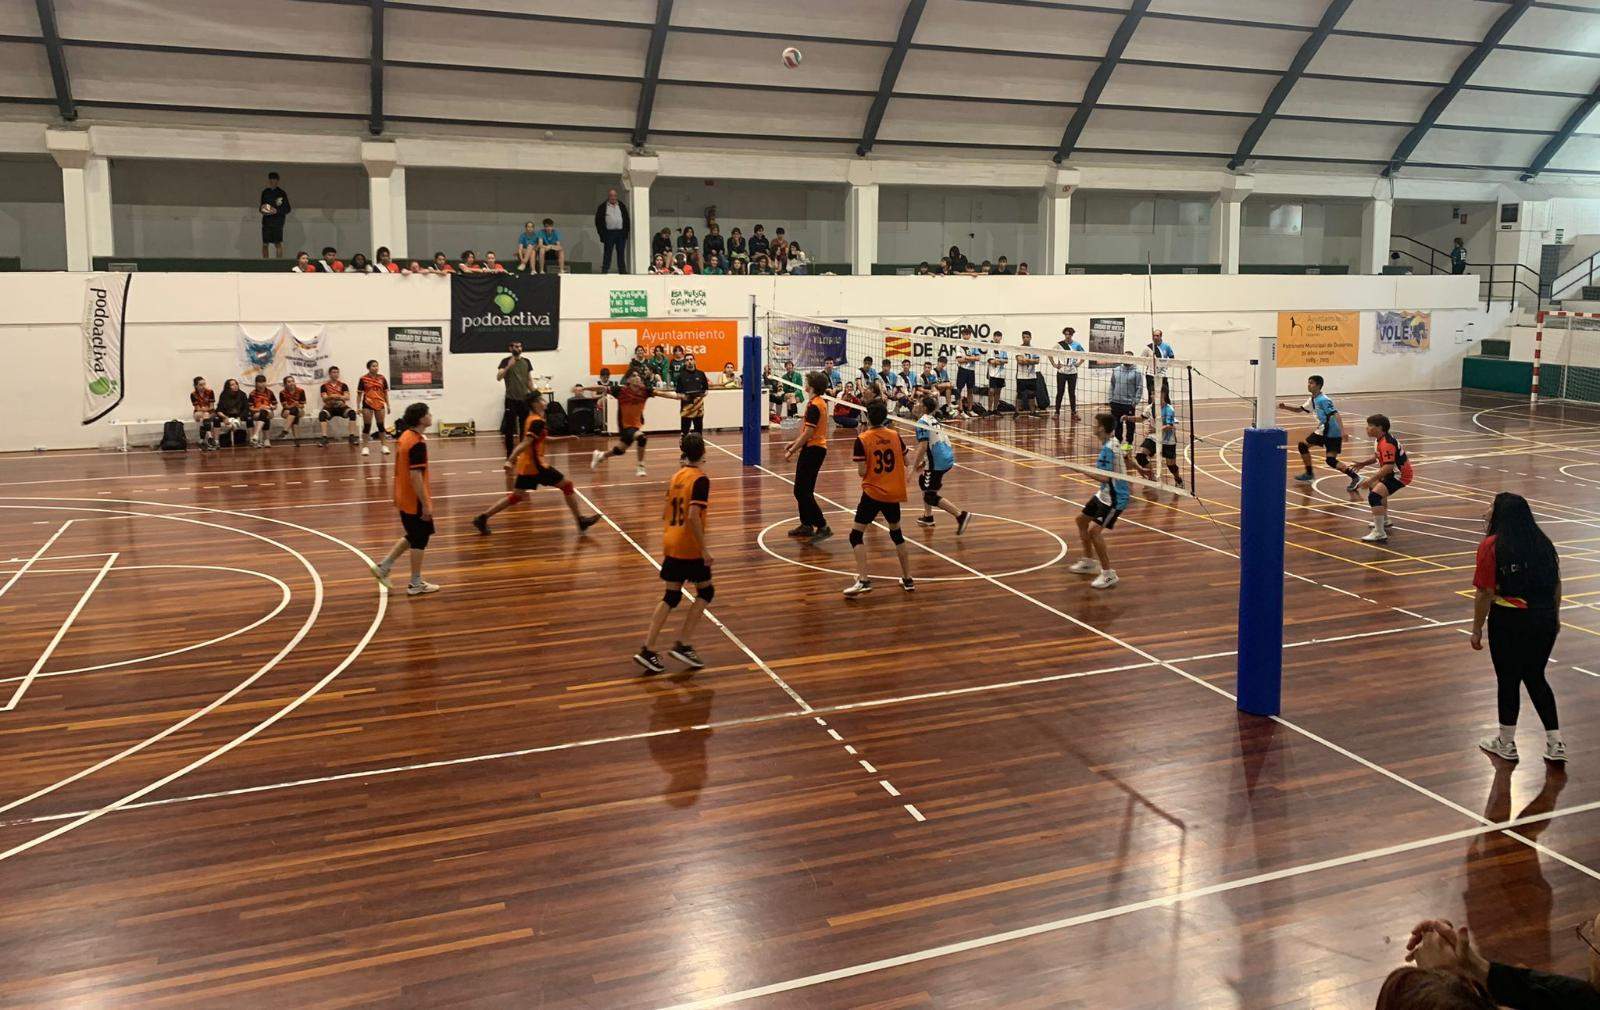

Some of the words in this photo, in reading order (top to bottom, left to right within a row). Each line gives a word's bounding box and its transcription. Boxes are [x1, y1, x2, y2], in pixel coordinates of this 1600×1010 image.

[684, 289, 706, 298] HUESCA
[90, 287, 109, 373] podoactiva
[462, 312, 551, 333] podoactiva
[642, 329, 725, 343] Ayuntamiento
[913, 343, 933, 357] DE
[873, 448, 895, 474] 39
